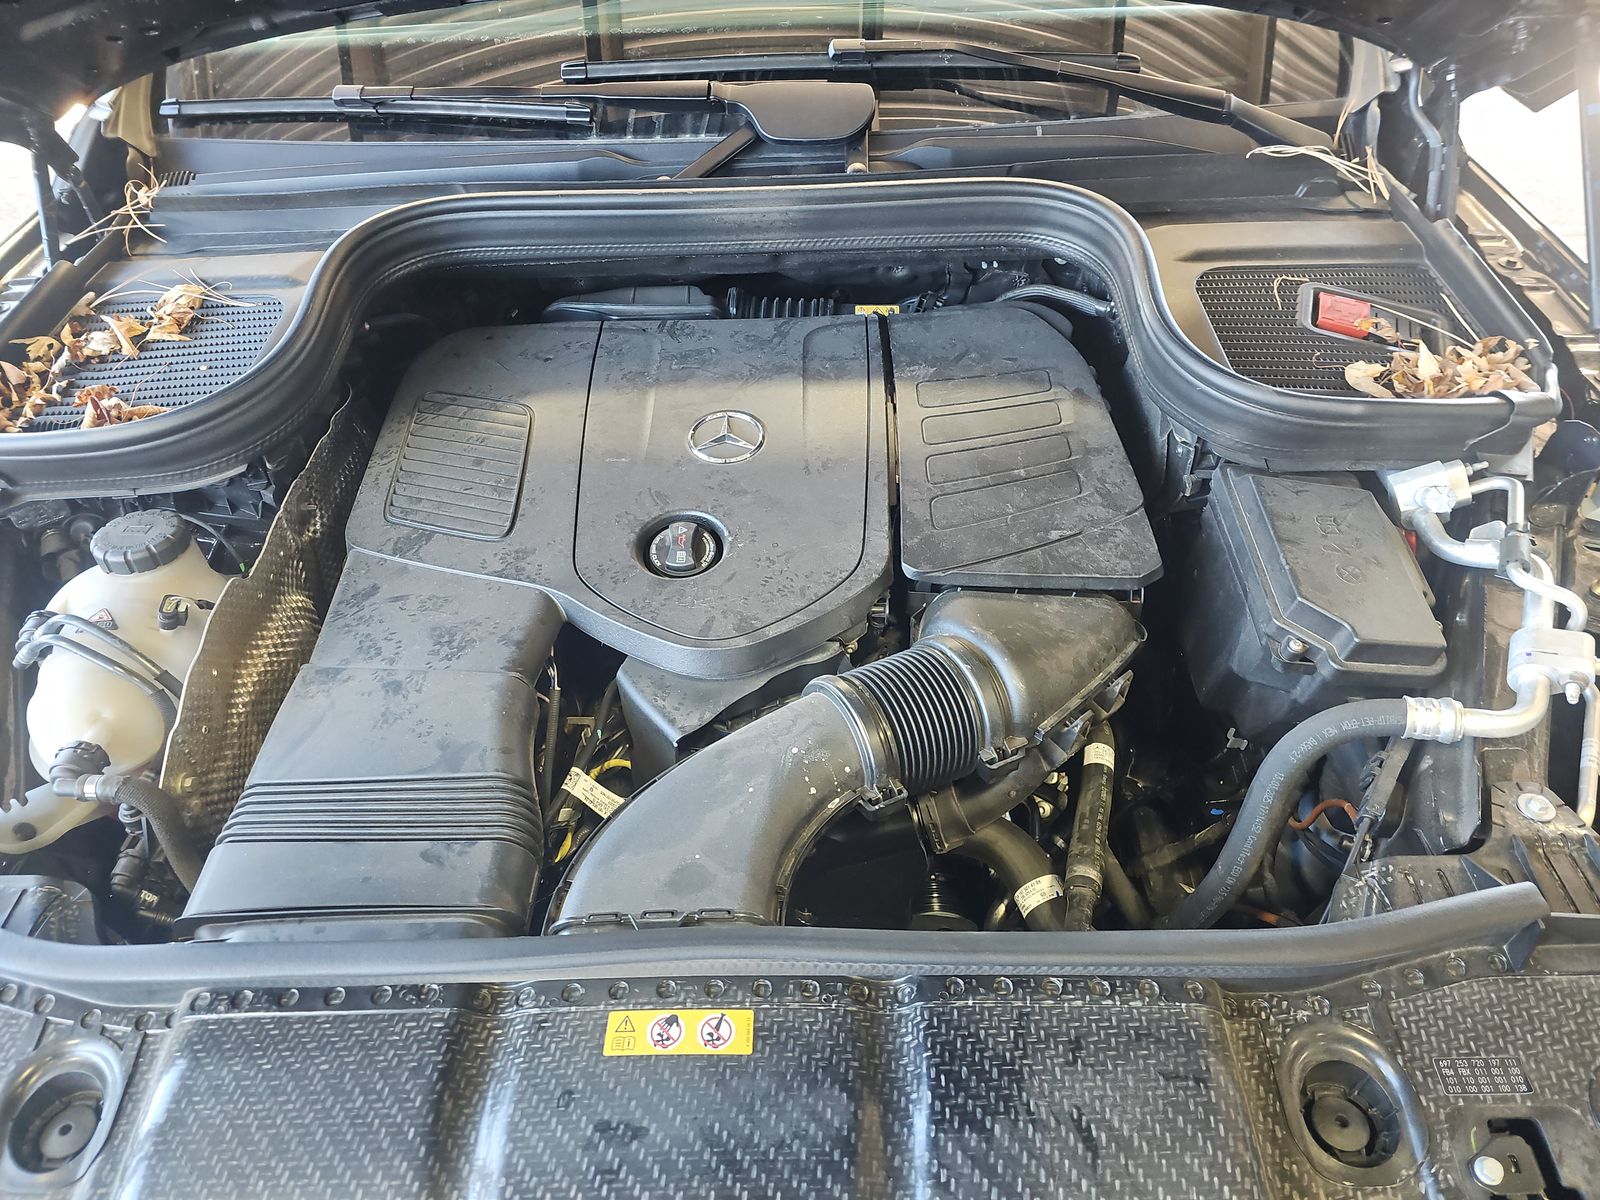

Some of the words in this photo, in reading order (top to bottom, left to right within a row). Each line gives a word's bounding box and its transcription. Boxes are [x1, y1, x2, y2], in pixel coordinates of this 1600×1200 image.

[140, 890, 159, 903] TOP
[1439, 1059, 1451, 1067] 697
[1455, 1059, 1468, 1067] 253
[1471, 1059, 1485, 1067] 720
[1488, 1059, 1500, 1067] 197
[1504, 1059, 1516, 1067] 111
[1441, 1067, 1454, 1076] FB4
[1458, 1067, 1471, 1076] FBX
[1474, 1067, 1487, 1076] 011
[1491, 1067, 1504, 1076] 001
[1508, 1067, 1521, 1076] 100
[1445, 1076, 1458, 1084] 101
[1462, 1076, 1475, 1084] 110
[1478, 1076, 1491, 1084] 001
[1494, 1076, 1507, 1084] 001
[1510, 1076, 1524, 1084] 010
[1448, 1085, 1461, 1093] 010
[1465, 1085, 1478, 1093] 100
[1481, 1085, 1494, 1093] 001
[1498, 1085, 1511, 1093] 100
